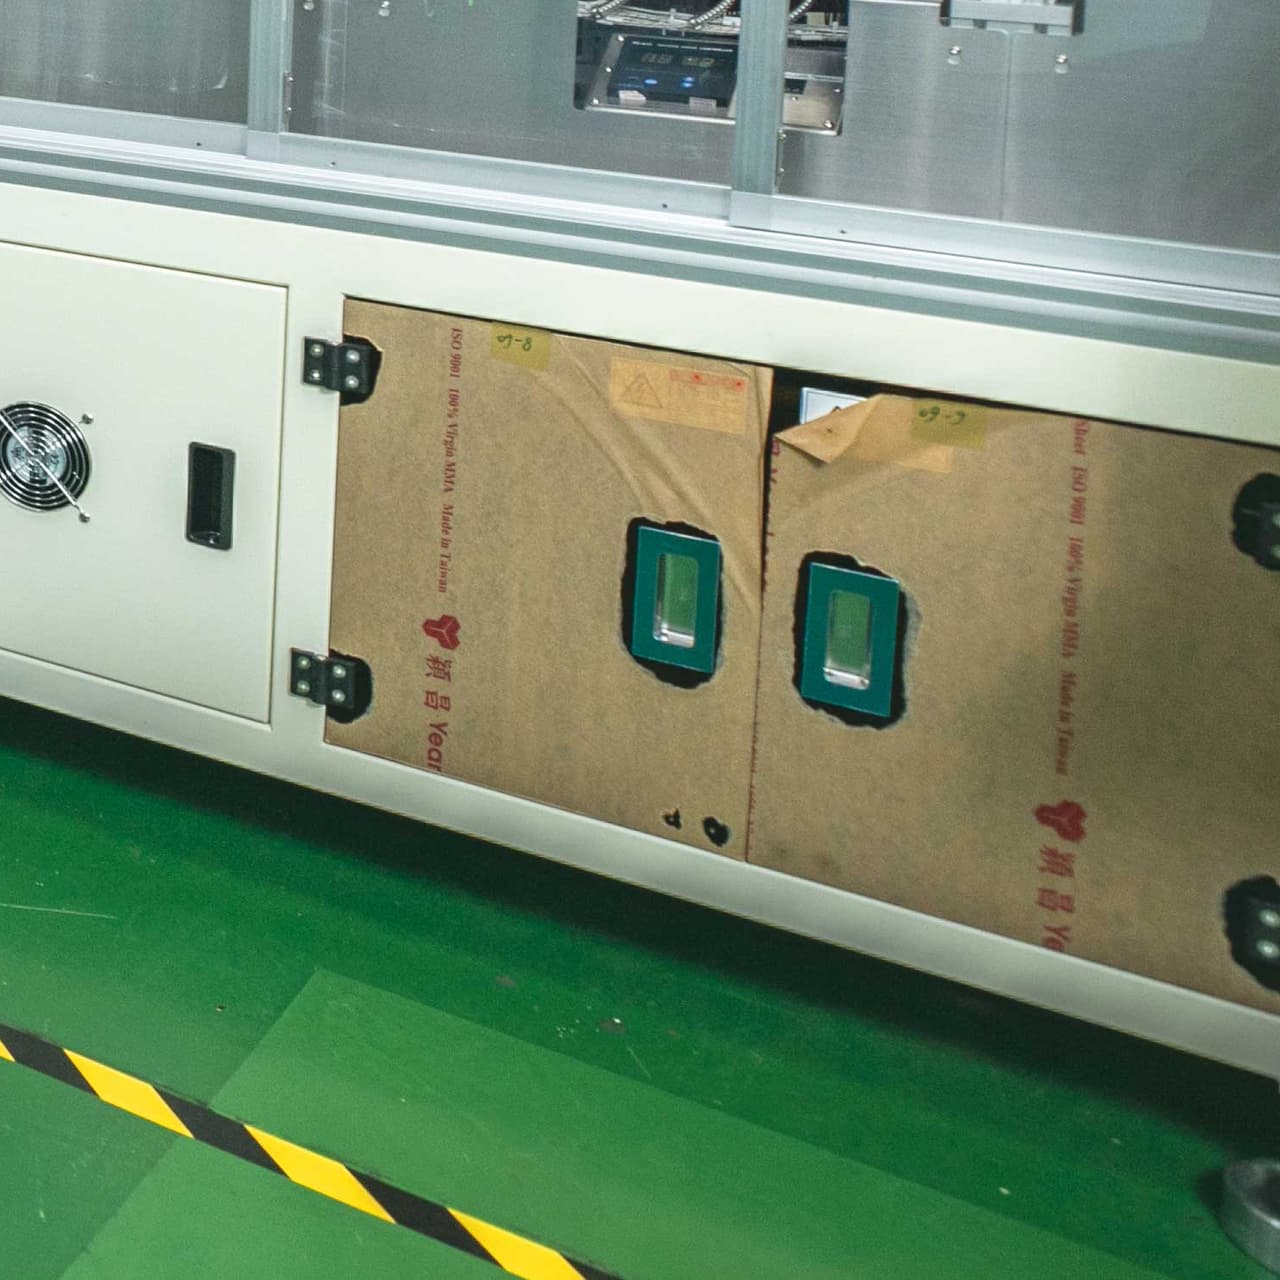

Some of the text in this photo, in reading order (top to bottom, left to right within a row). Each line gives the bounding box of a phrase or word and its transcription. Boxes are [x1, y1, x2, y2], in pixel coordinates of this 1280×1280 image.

[438, 328, 463, 593] ISO 9001 100% Virgin MMA Made in Taiwan
[1071, 465, 1088, 492] ISO
[1059, 671, 1078, 706] Made
[1056, 727, 1076, 777] Taiwan
